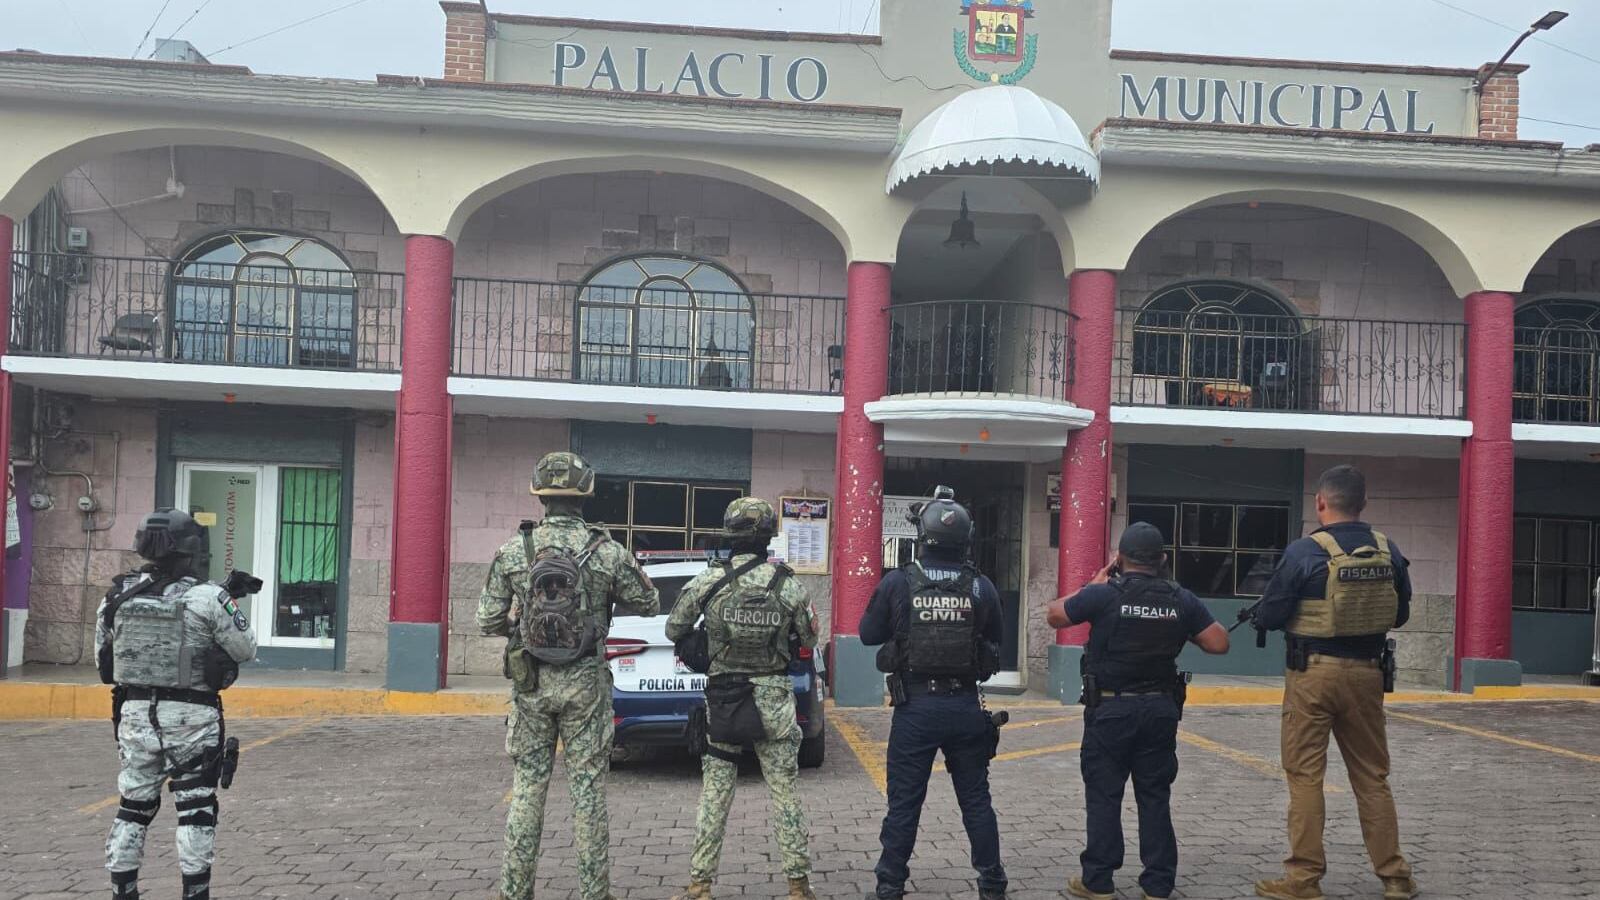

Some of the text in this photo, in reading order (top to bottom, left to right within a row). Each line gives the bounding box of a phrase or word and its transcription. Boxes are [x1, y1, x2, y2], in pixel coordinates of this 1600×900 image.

[554, 42, 1435, 134] PALACIO MUNICIPAL
[913, 597, 972, 609] GUARDIA
[919, 610, 966, 621] CIVIL
[639, 675, 685, 691] POLICÍA
